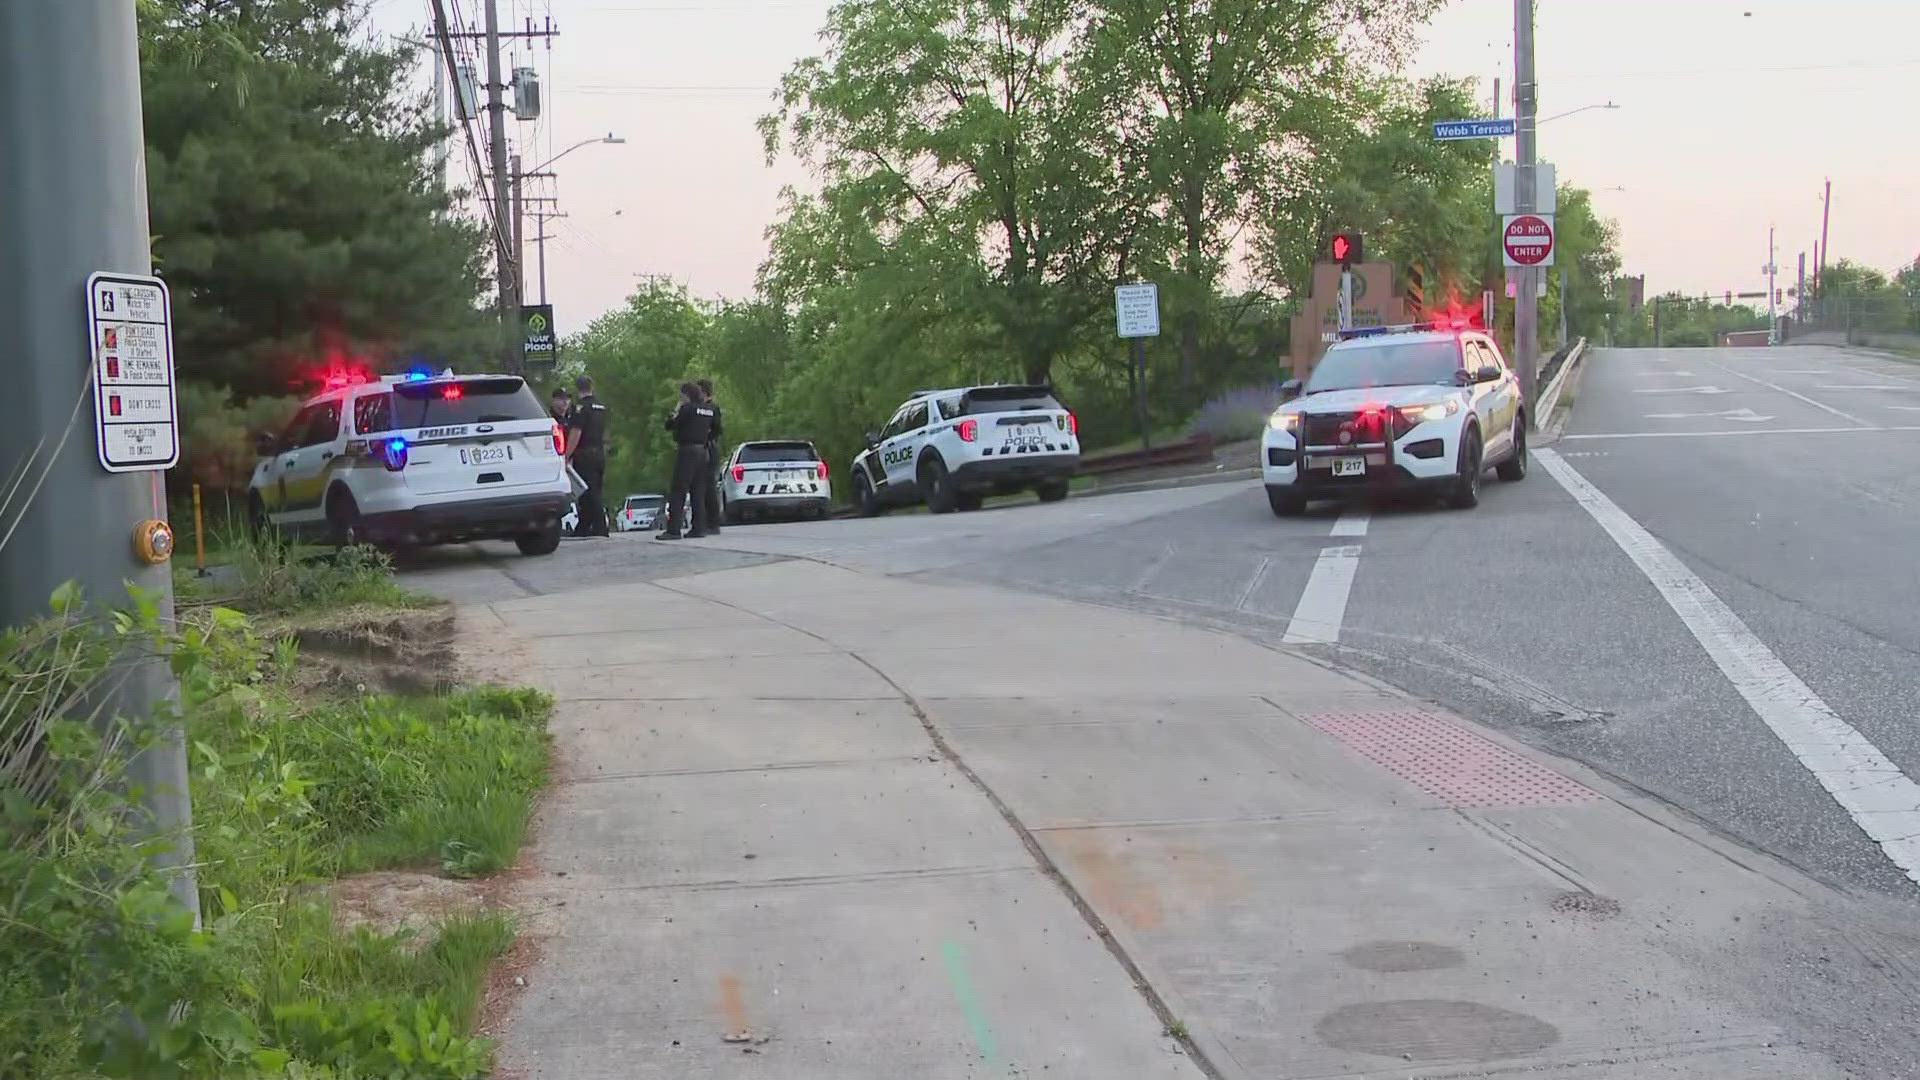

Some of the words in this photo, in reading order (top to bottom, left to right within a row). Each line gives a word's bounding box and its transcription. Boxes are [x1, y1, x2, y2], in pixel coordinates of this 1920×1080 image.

[1437, 126, 1468, 136] Webb
[1471, 125, 1512, 135] Terrace
[1511, 226, 1523, 234] DO
[1528, 225, 1546, 233] NOT
[1514, 247, 1542, 256] ENTER
[524, 343, 553, 352] Place
[418, 426, 468, 439] POLICE
[1005, 436, 1047, 446] POLICE
[482, 449, 504, 459] 223
[885, 446, 912, 465] POLICE
[1346, 461, 1361, 470] 217
